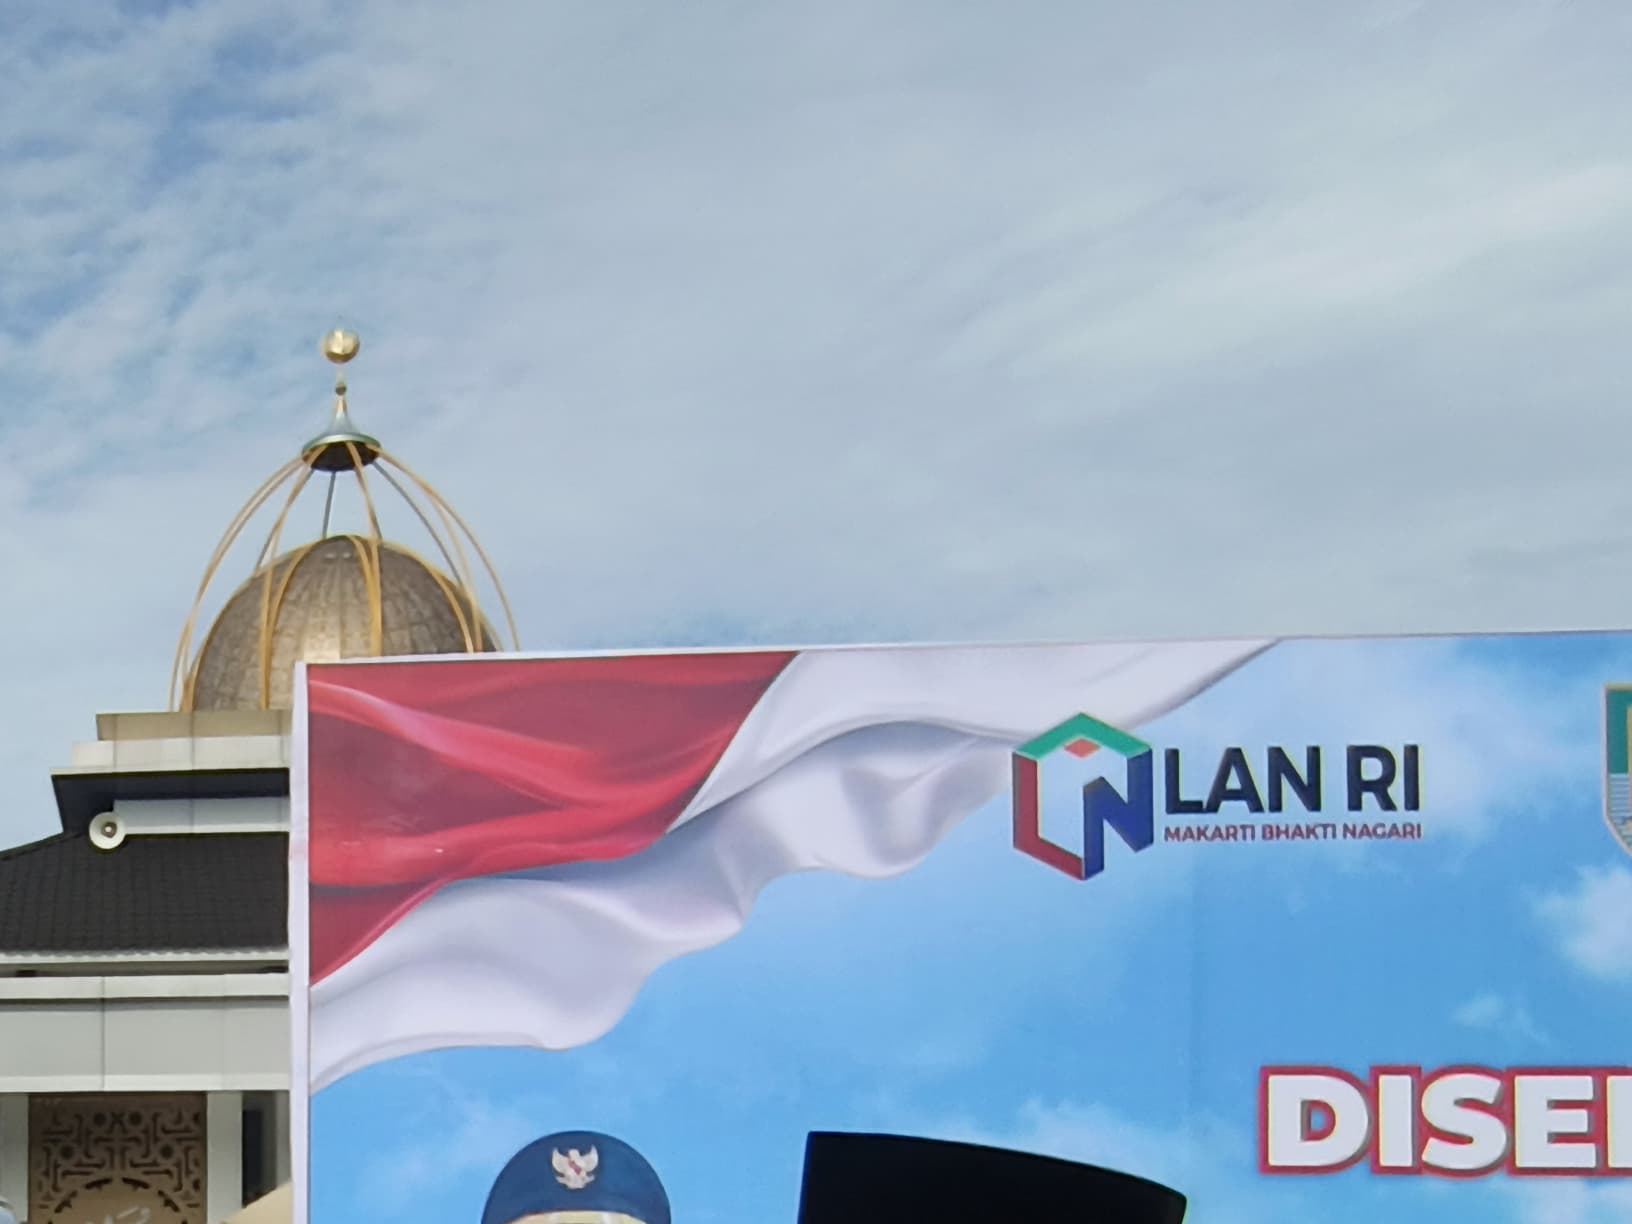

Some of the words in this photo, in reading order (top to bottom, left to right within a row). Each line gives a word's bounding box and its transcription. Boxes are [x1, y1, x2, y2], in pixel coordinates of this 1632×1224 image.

[1164, 745, 1322, 815] LAN
[1346, 744, 1421, 812] RI
[1164, 824, 1256, 843] MAKARTI
[1261, 823, 1337, 842] BHAKTI
[1342, 822, 1422, 841] NAGARI
[1258, 1066, 1632, 1178] DISE
